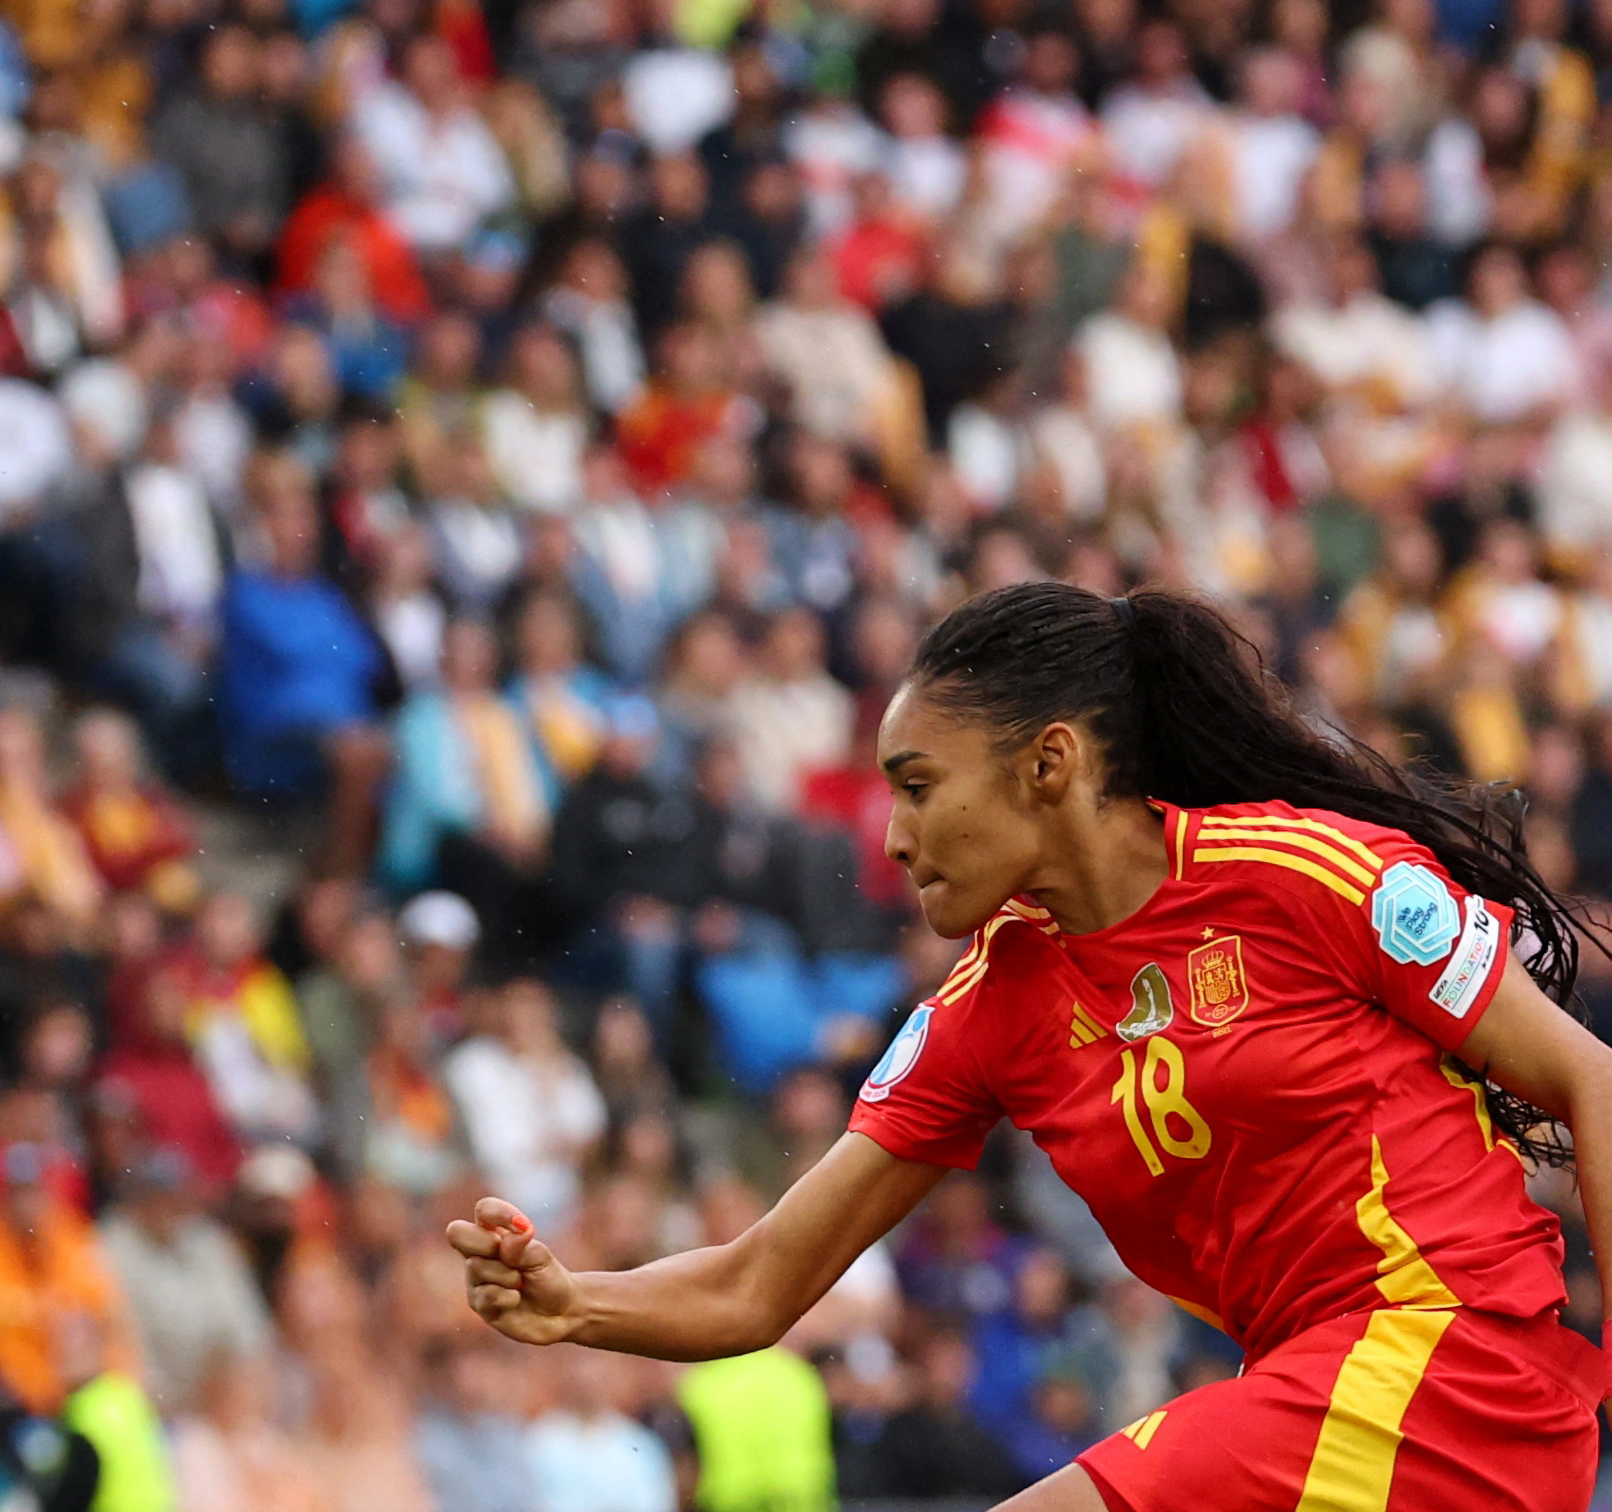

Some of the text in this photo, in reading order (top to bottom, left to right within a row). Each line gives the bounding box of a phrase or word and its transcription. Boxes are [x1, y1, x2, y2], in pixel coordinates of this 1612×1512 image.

[1406, 907, 1424, 930] Play
[1414, 902, 1438, 936] Strong
[1443, 935, 1485, 1008] FOUNDATION
[1110, 1036, 1212, 1177] 18
